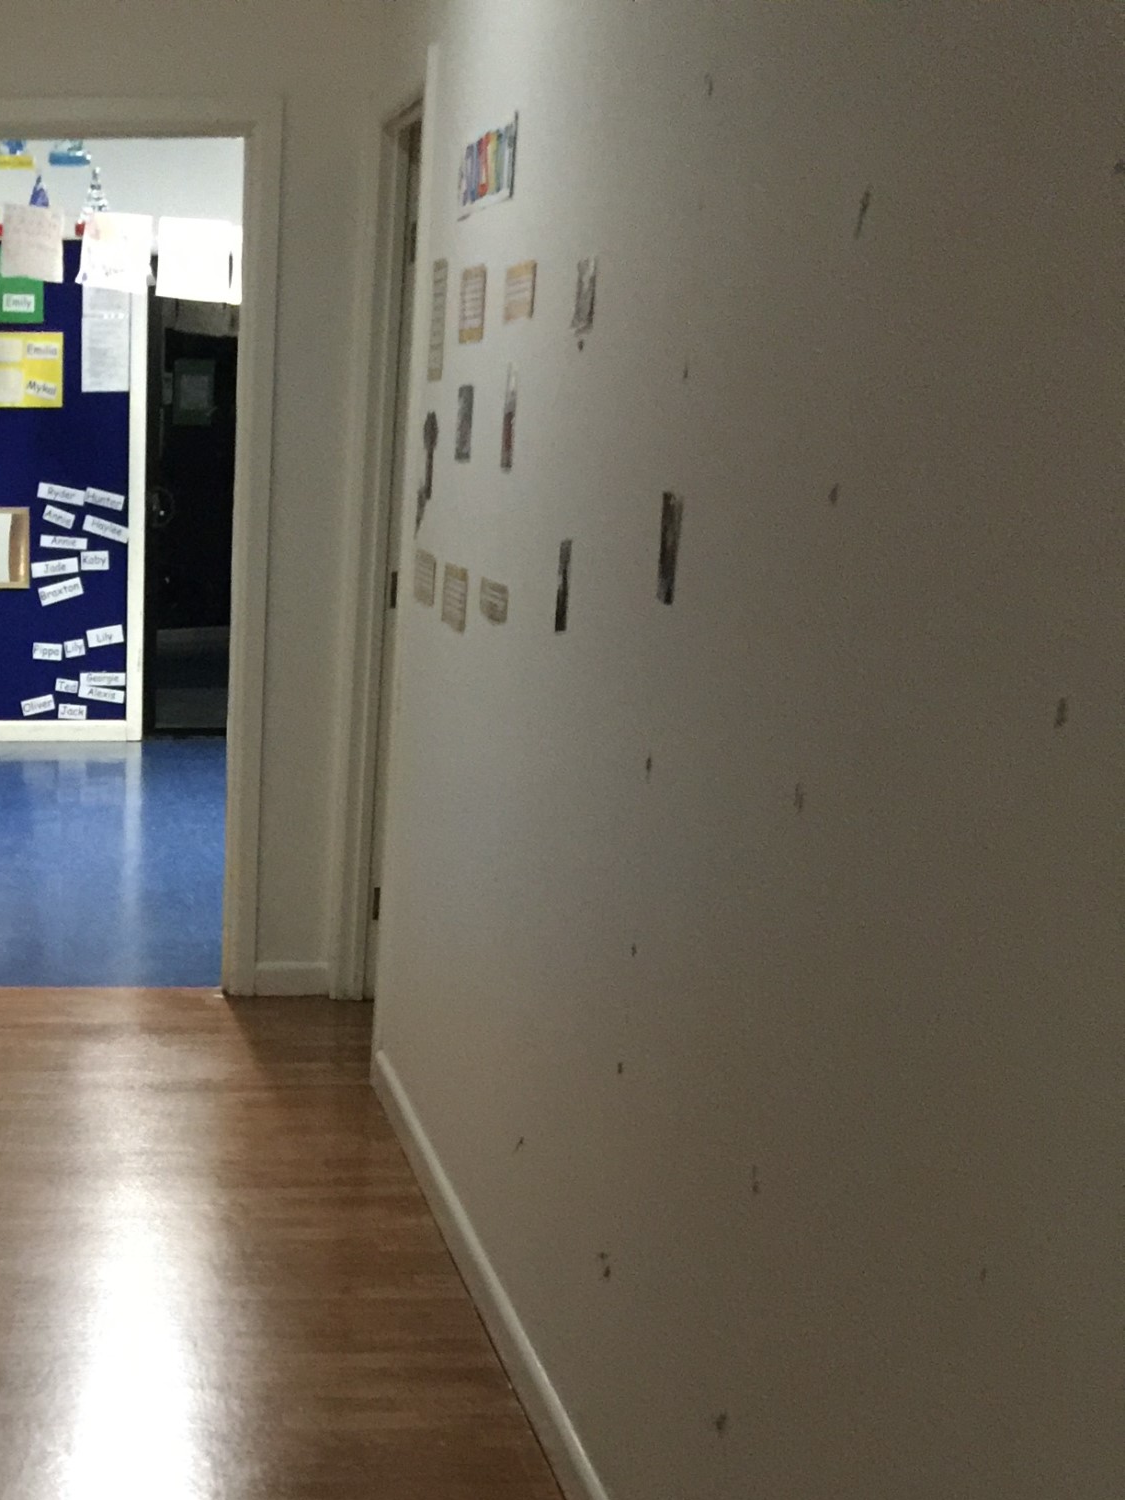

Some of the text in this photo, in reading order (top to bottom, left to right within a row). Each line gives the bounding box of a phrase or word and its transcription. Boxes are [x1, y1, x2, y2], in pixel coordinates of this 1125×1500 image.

[6, 295, 32, 309] Emily
[47, 486, 76, 500] Ryder
[85, 491, 122, 506] Hunter
[40, 583, 80, 601] Braxton
[33, 644, 60, 658] Pippa
[23, 698, 53, 713] Oliver
[60, 705, 85, 716] Jack
